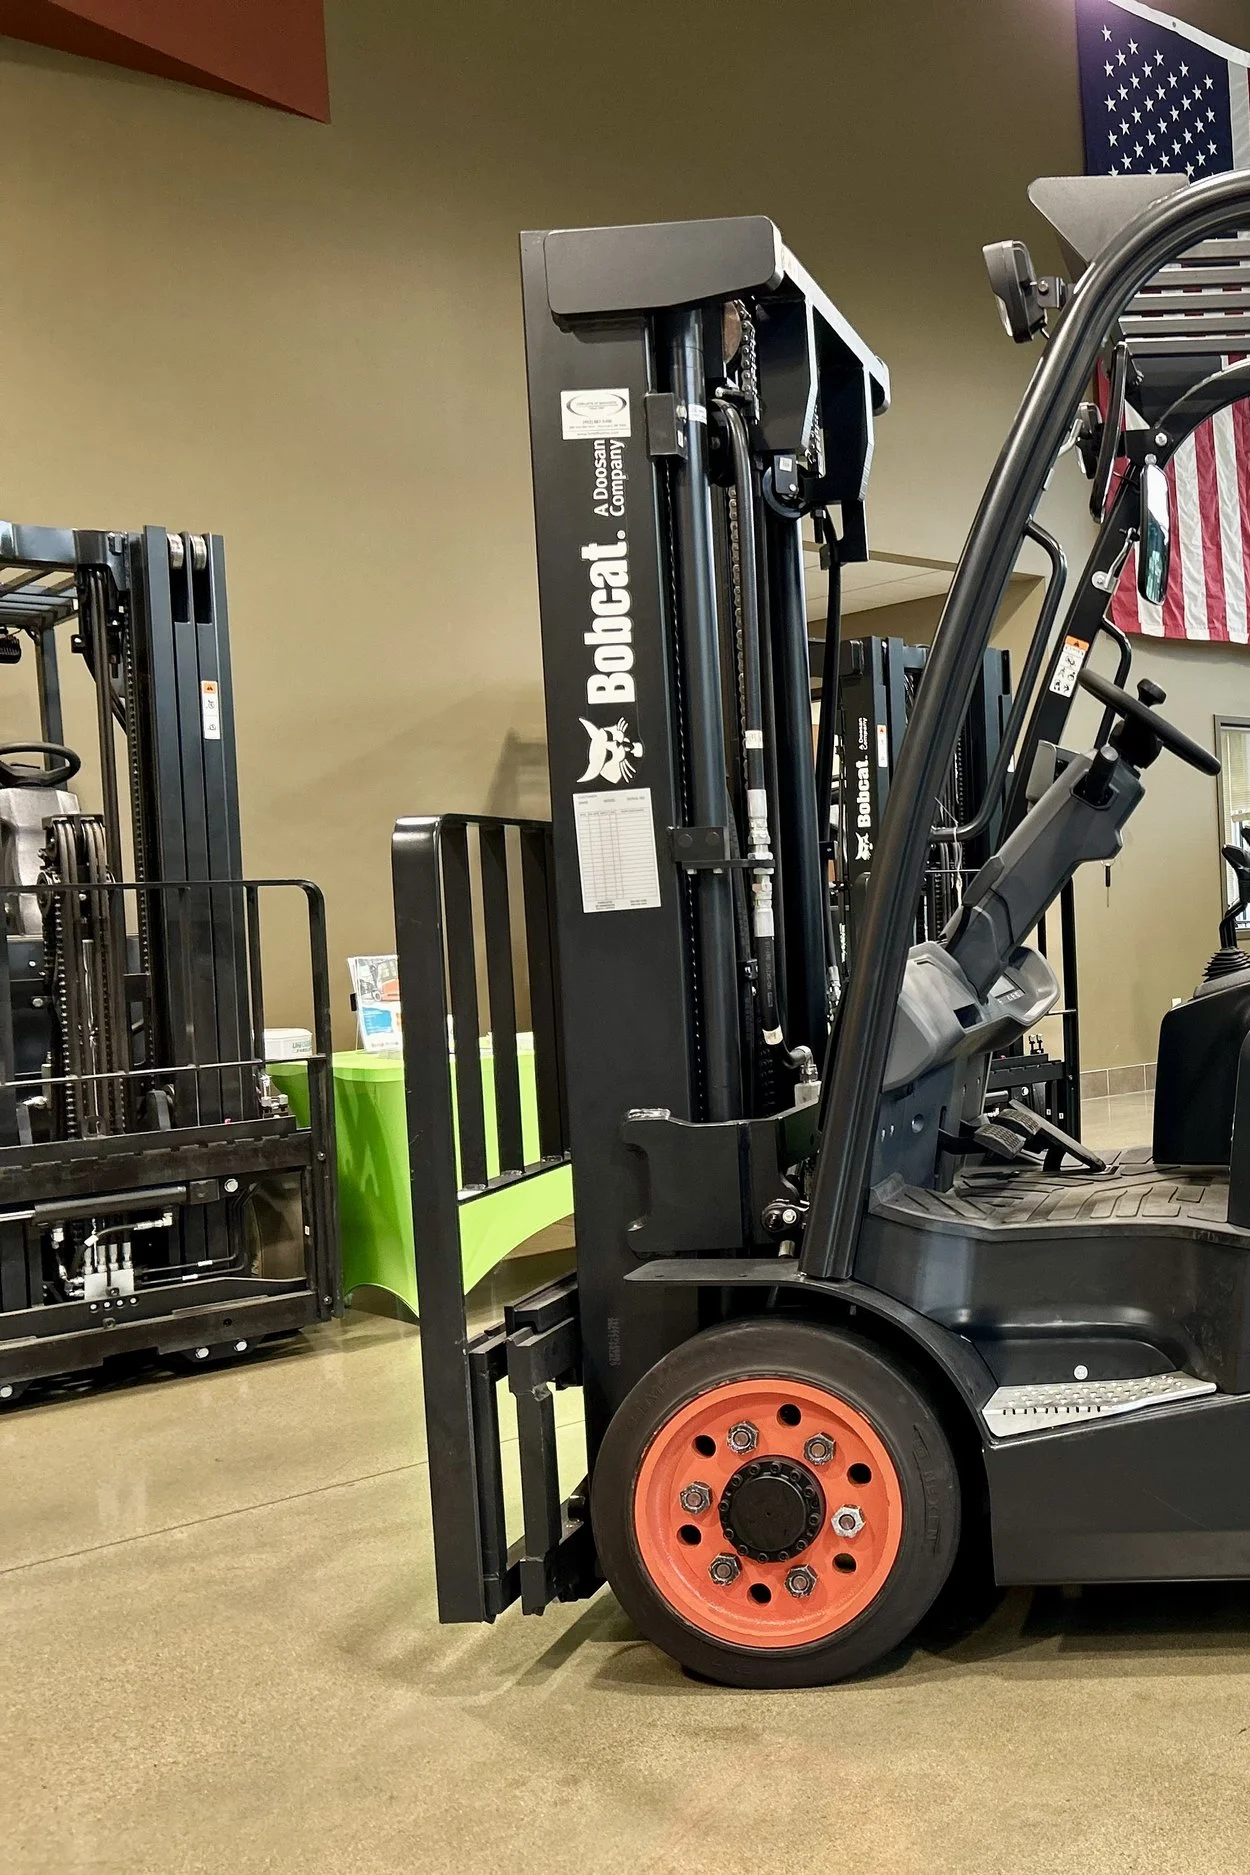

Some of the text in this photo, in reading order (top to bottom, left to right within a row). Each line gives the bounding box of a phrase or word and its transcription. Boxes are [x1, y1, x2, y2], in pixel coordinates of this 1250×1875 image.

[592, 439, 609, 500] Doosan
[609, 439, 626, 517] Company
[593, 502, 609, 517] A
[580, 541, 636, 705] Bobcat
